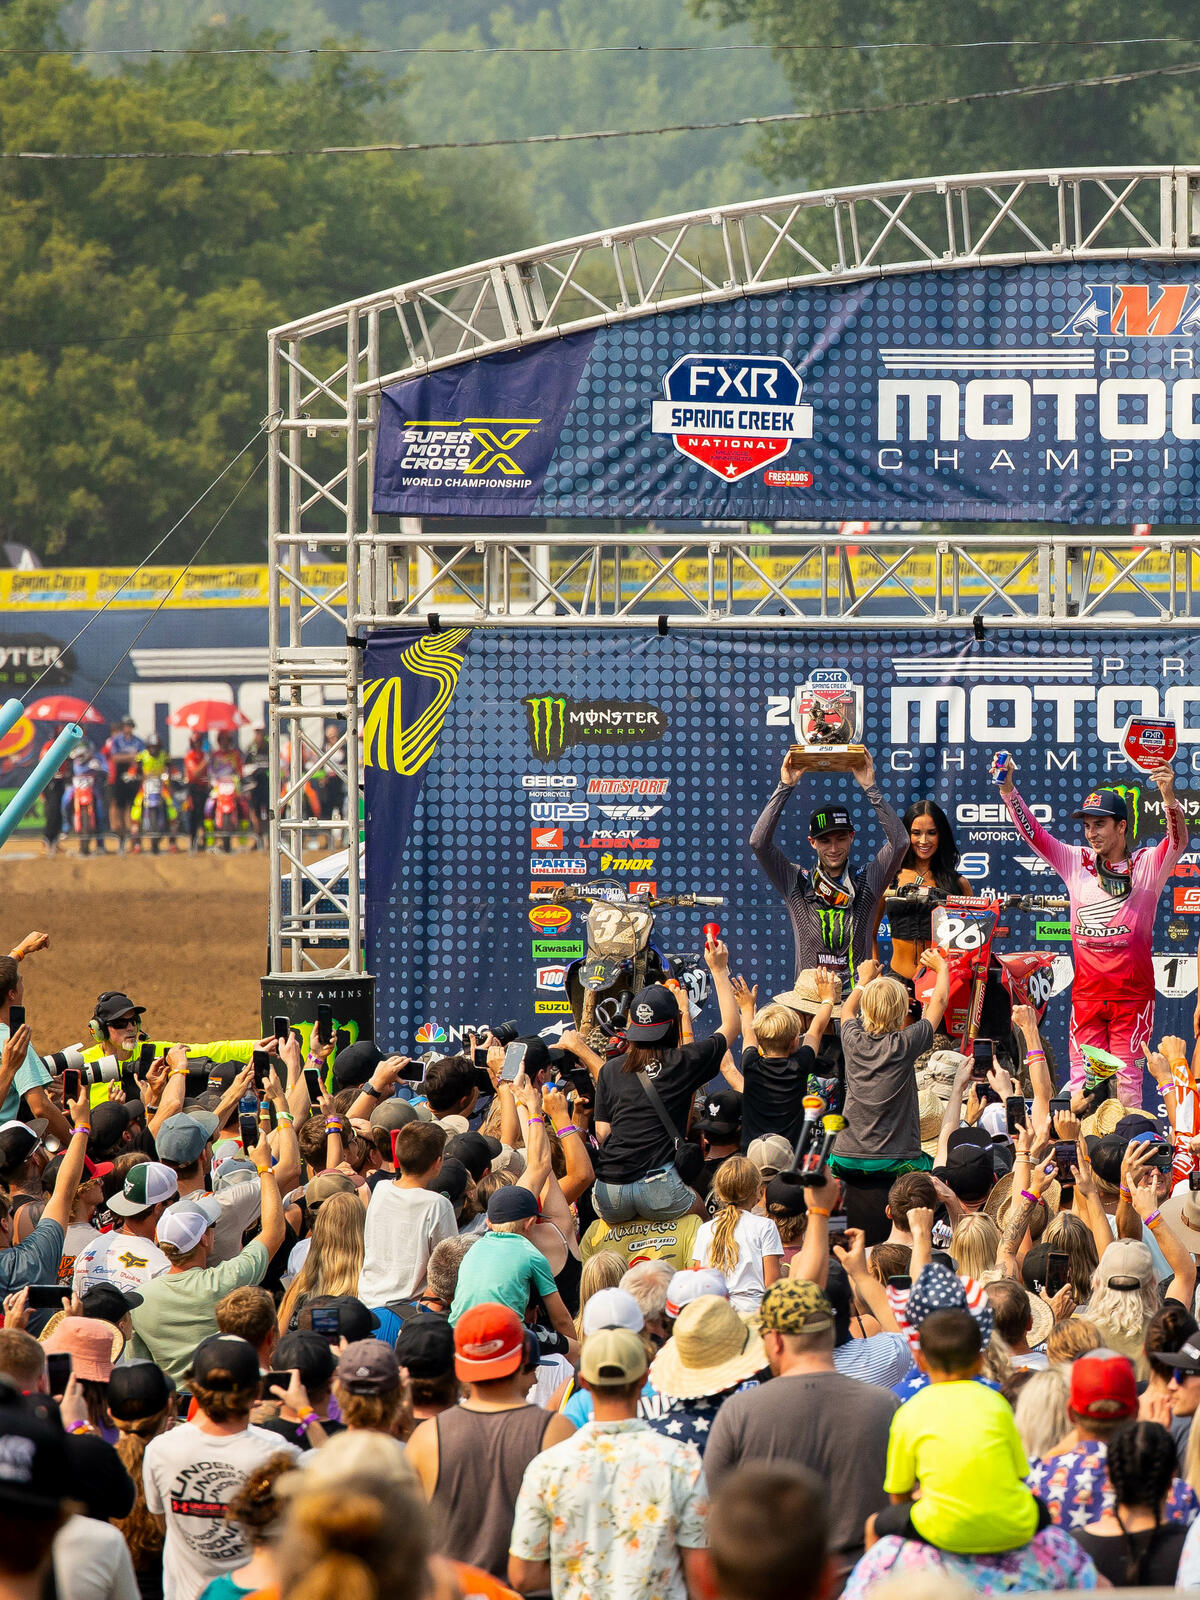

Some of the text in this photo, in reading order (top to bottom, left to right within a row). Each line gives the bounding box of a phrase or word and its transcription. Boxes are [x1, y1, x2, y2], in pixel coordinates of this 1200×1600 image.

[690, 366, 778, 399] FXR
[671, 408, 794, 431] SPRING CREEK
[402, 431, 475, 444] SUPER
[688, 438, 777, 450] NATIONAL
[406, 444, 471, 458] MOTO
[400, 457, 472, 471] CROSS
[402, 477, 532, 489] WORLD CHAMPIONSHIP
[768, 472, 809, 482] FRESCADOS
[816, 673, 842, 681] FXR
[570, 709, 660, 727] MONSTER
[522, 776, 577, 787] GEICO
[531, 803, 589, 821] WPS
[597, 805, 664, 817] FLY
[956, 804, 1053, 823] GEIO
[1012, 797, 1036, 840] HONDA
[592, 829, 640, 839] MX-ATV
[969, 831, 1025, 842] MOTORCY
[579, 838, 660, 850] LEGENDS
[532, 859, 586, 868] PARTS
[612, 858, 654, 871] THOR
[531, 910, 570, 919] FMF
[593, 908, 649, 944] 32
[1039, 926, 1072, 935] Kawas
[1075, 925, 1131, 937] HONDA
[936, 918, 986, 950] 96
[535, 944, 582, 953] Kawasaki
[542, 972, 565, 986] 100
[683, 968, 709, 1002] 32
[278, 989, 363, 999] BVITAMINS
[1029, 972, 1051, 1006] 96
[538, 1003, 570, 1011] SUZU
[604, 1224, 650, 1242] Mixing
[171, 1461, 235, 1498] UNDER
